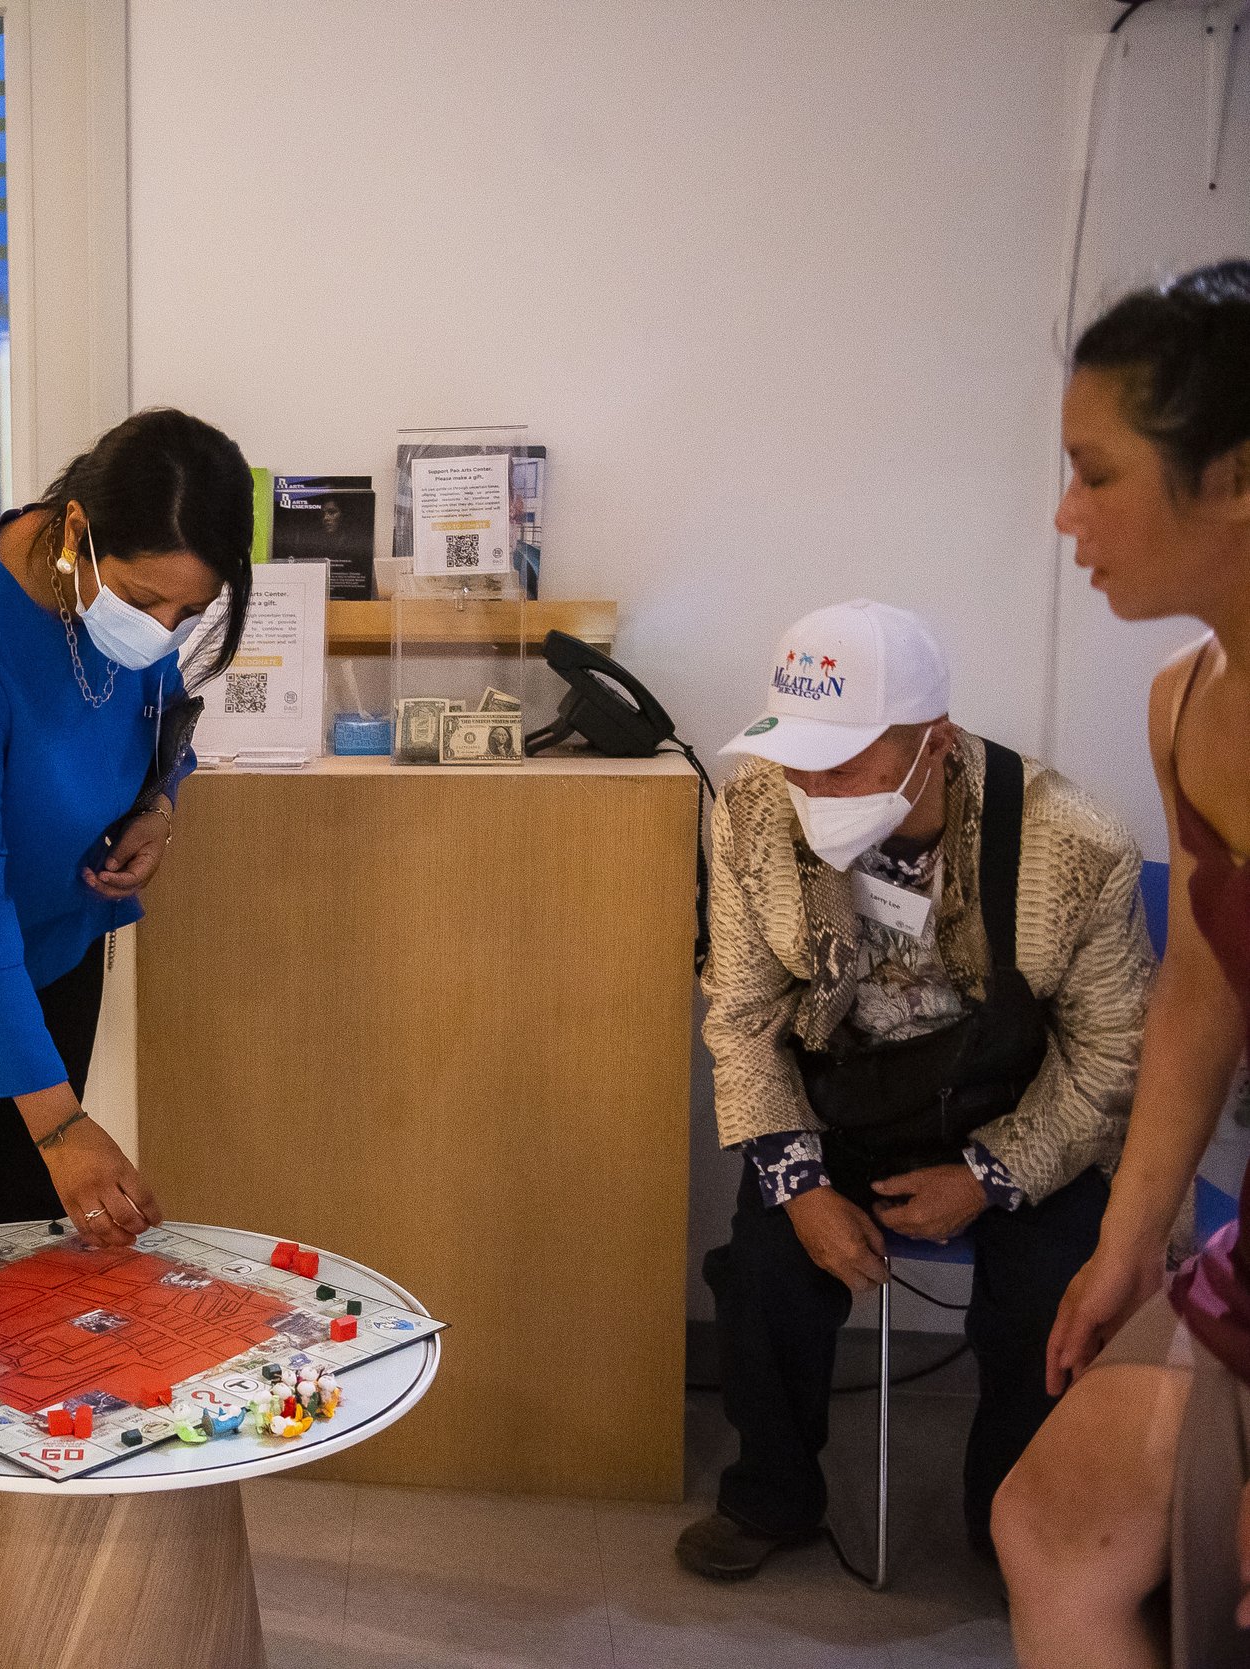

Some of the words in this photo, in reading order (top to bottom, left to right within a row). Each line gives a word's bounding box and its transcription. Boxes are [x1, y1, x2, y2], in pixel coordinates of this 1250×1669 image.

[777, 686, 820, 700] MEXICO
[870, 893, 887, 905] Larry
[889, 901, 900, 909] Lee
[41, 1449, 84, 1460] GO
